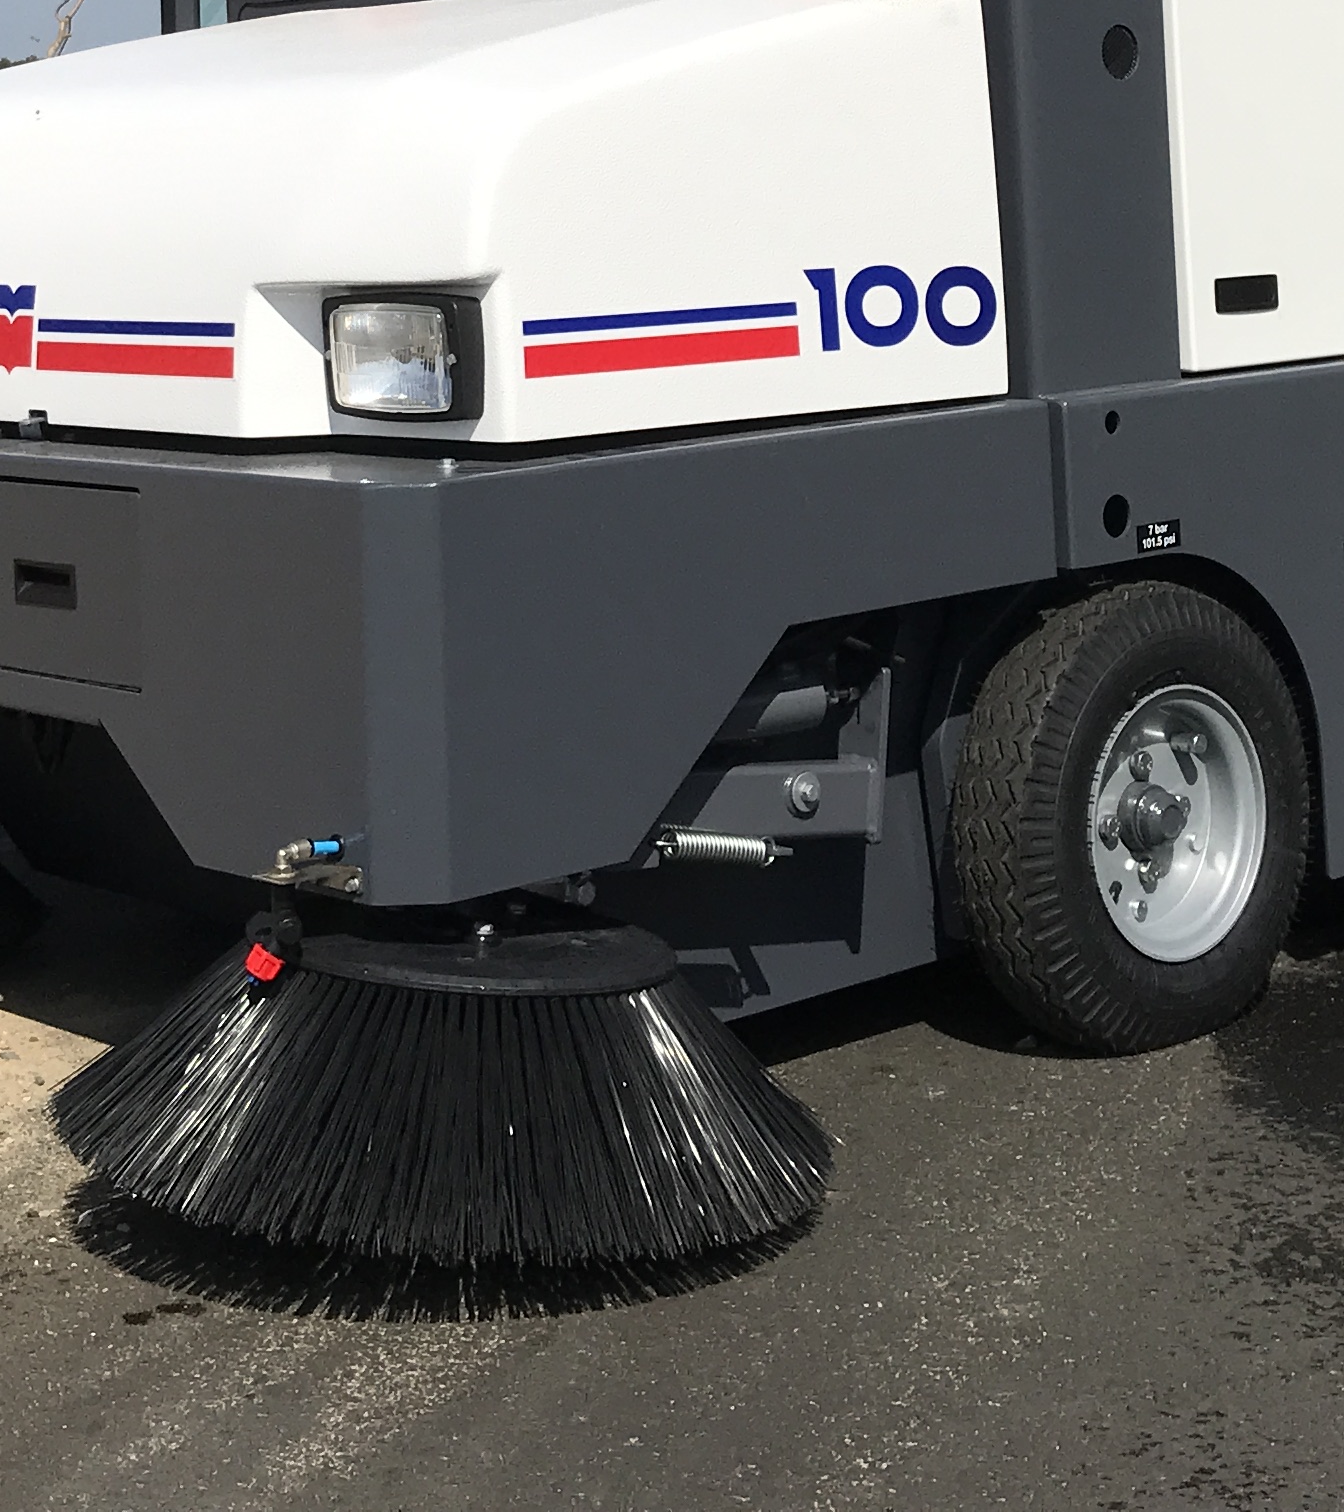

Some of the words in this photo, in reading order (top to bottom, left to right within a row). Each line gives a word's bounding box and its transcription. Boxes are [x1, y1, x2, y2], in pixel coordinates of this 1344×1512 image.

[803, 264, 997, 352] 100
[1147, 524, 1154, 536] 7
[1154, 524, 1169, 535] bar
[1163, 533, 1176, 548] psi
